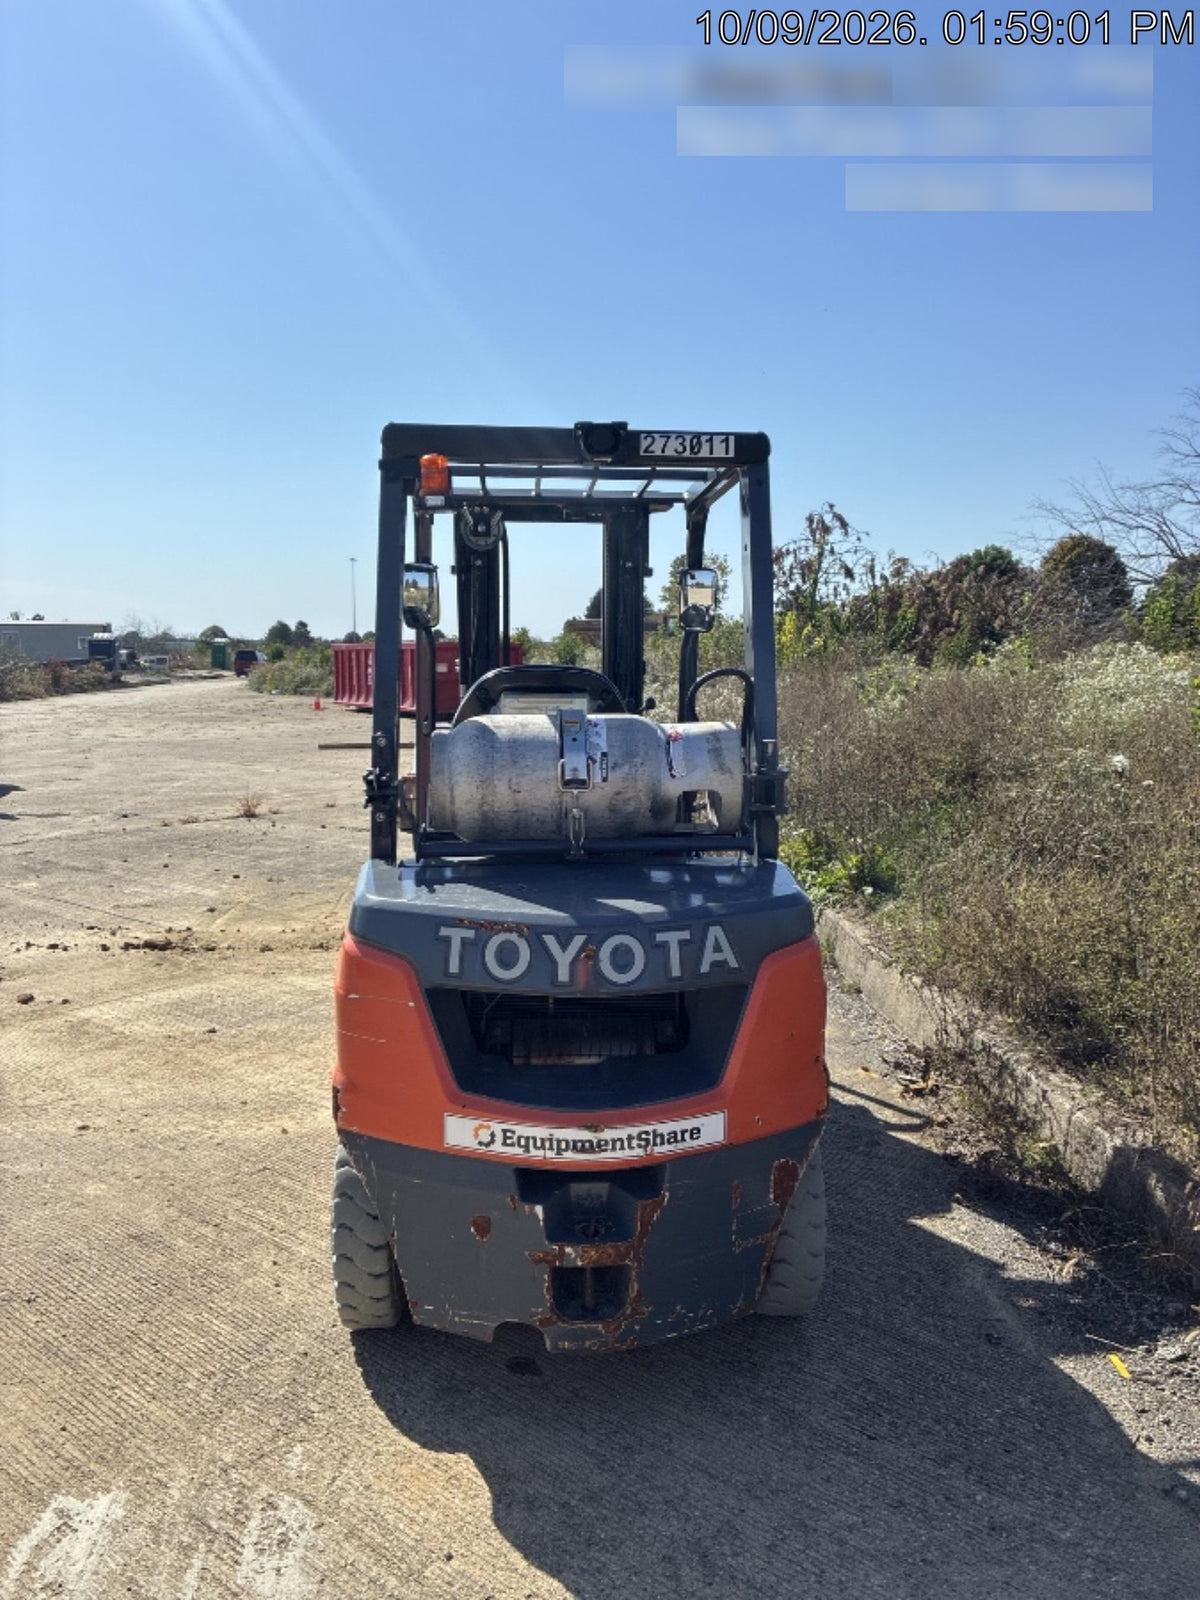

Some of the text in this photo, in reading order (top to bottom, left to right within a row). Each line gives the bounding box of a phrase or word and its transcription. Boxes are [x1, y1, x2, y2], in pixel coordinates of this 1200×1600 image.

[643, 434, 730, 455] 273011
[439, 926, 739, 984] TOYOTA
[501, 1126, 701, 1156] EquipmentShare
